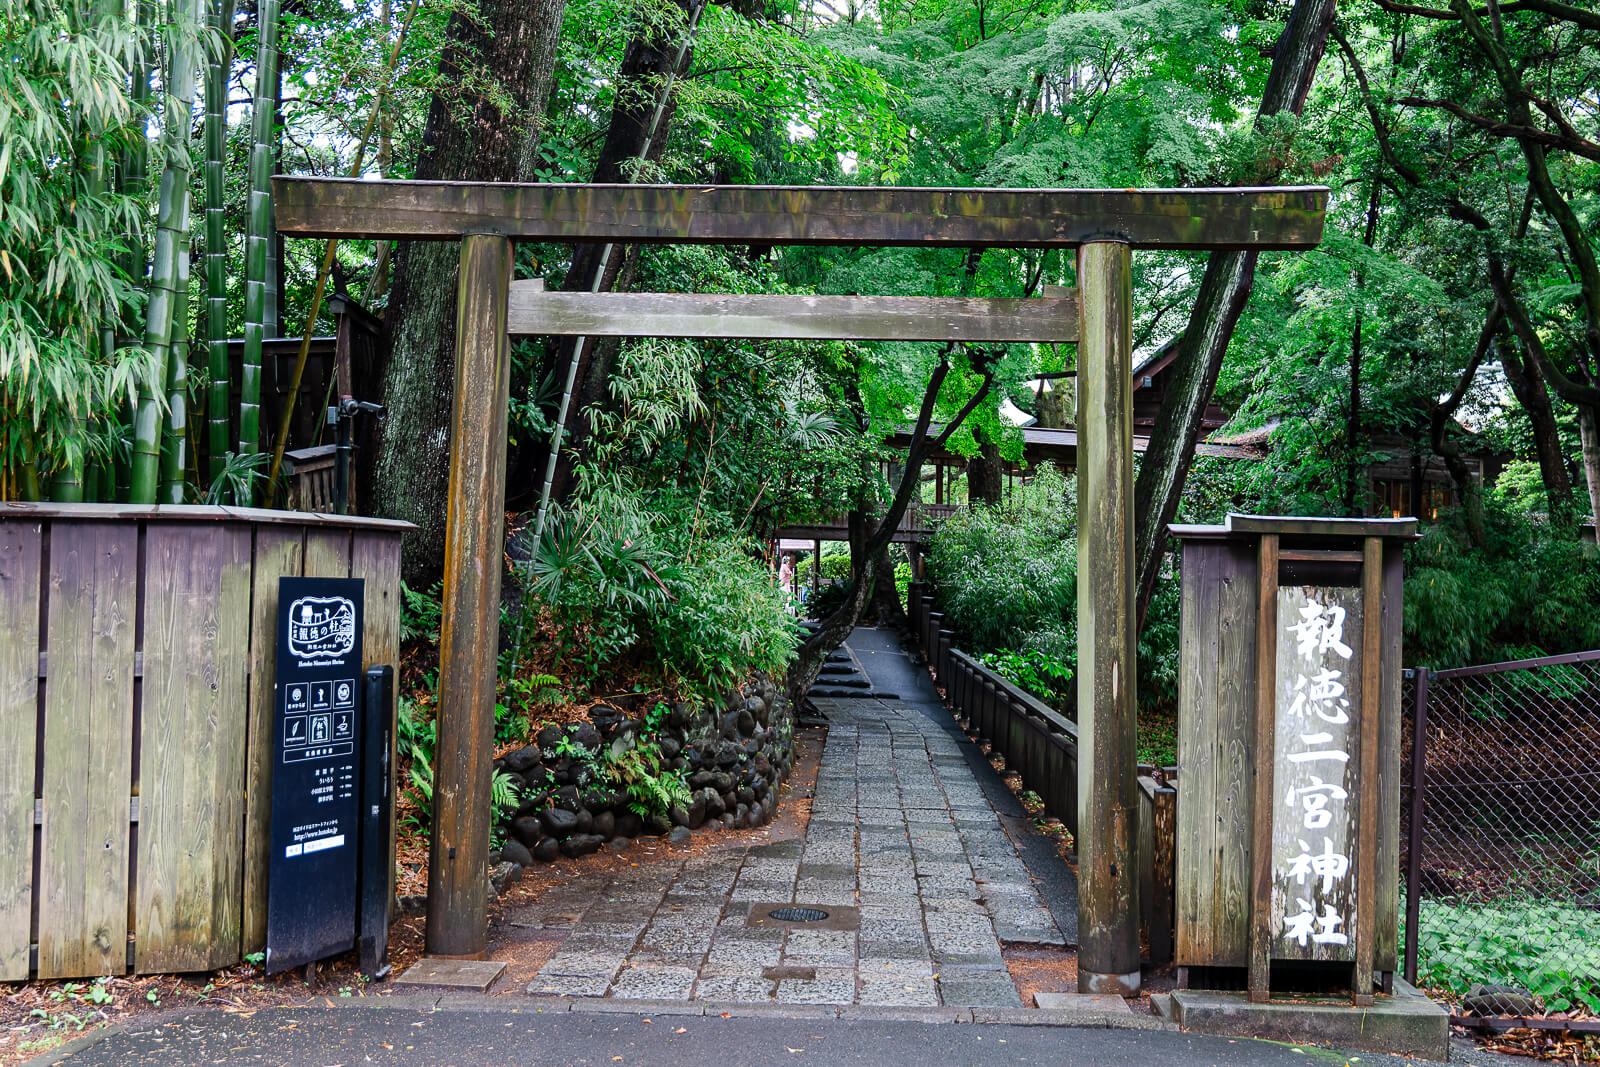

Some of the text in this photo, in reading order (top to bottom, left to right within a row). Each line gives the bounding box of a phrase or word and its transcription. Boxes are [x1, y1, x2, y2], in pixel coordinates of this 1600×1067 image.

[1284, 599, 1352, 947] 報徳二宮神社
